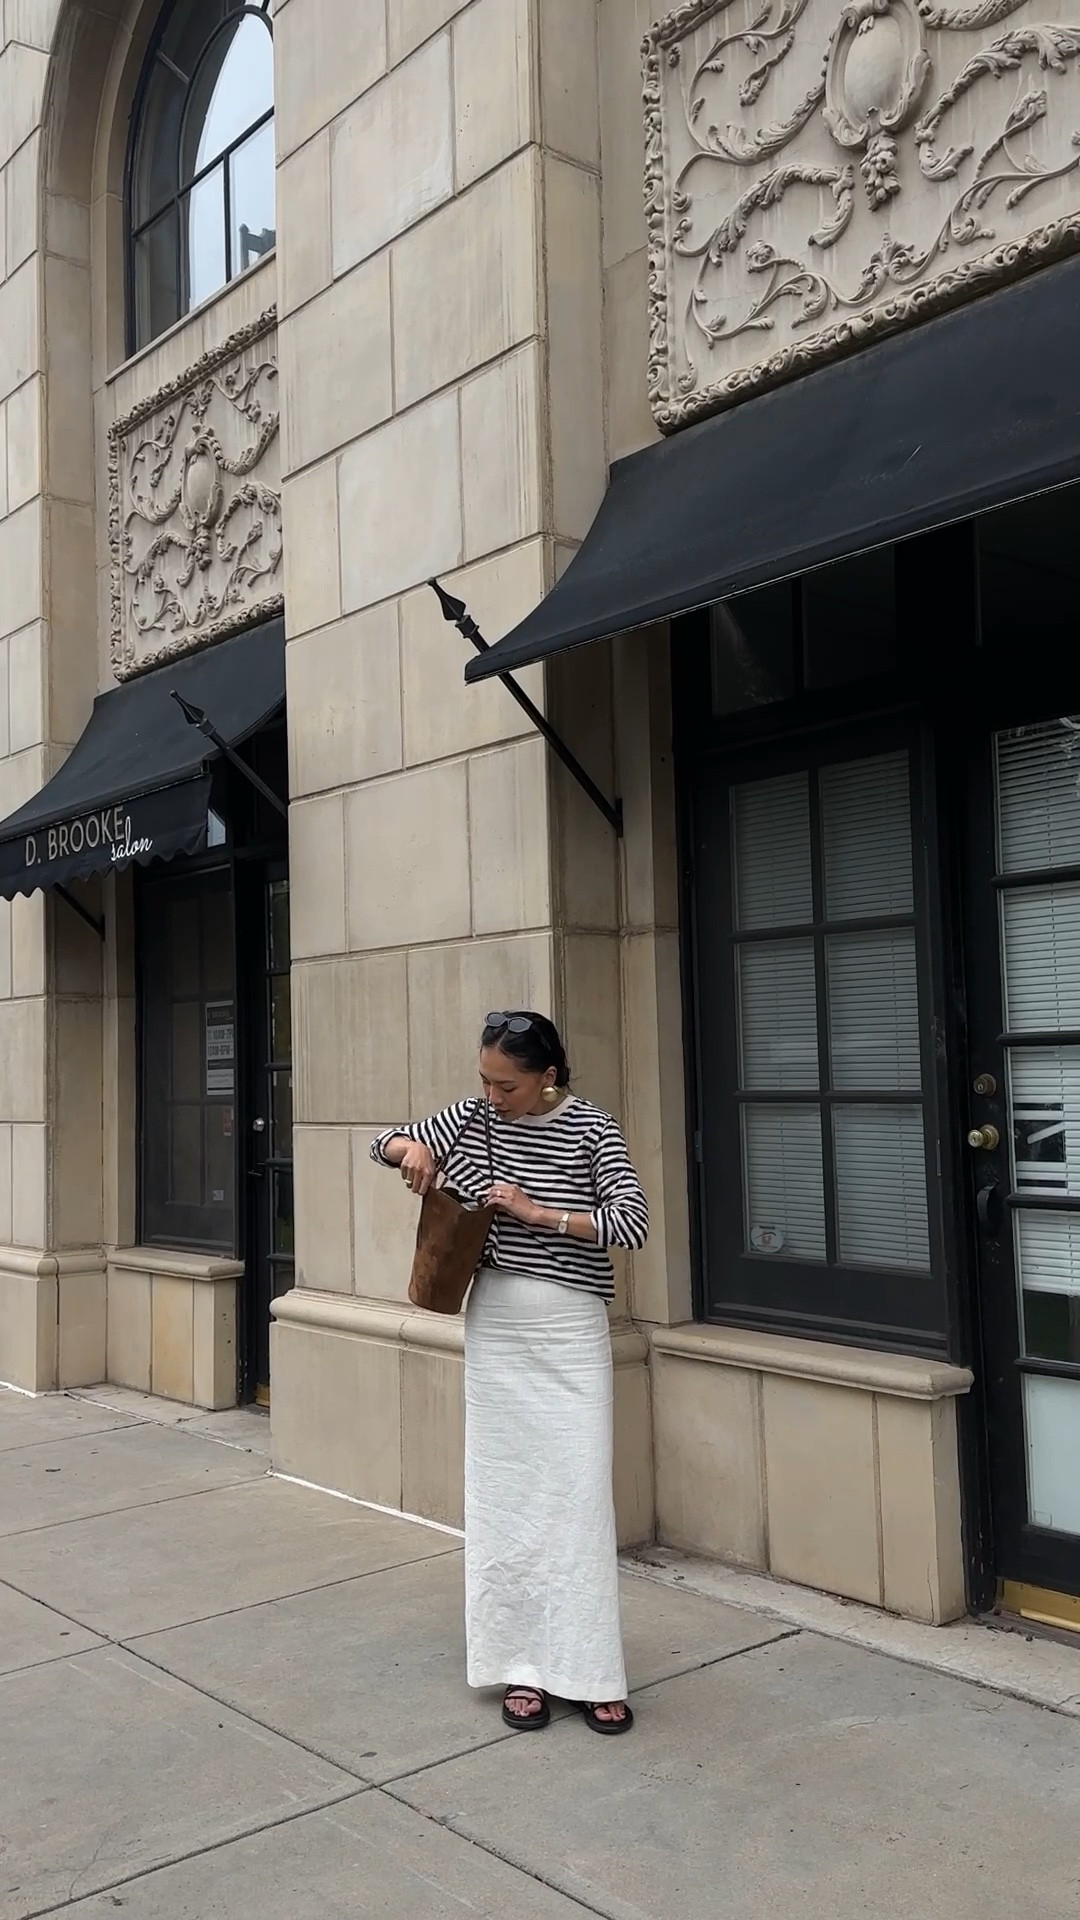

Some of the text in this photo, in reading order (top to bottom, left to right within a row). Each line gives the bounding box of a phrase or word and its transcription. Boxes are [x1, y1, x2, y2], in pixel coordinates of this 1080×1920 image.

[25, 805, 125, 867] D. BROOKE
[110, 815, 153, 861] salon
